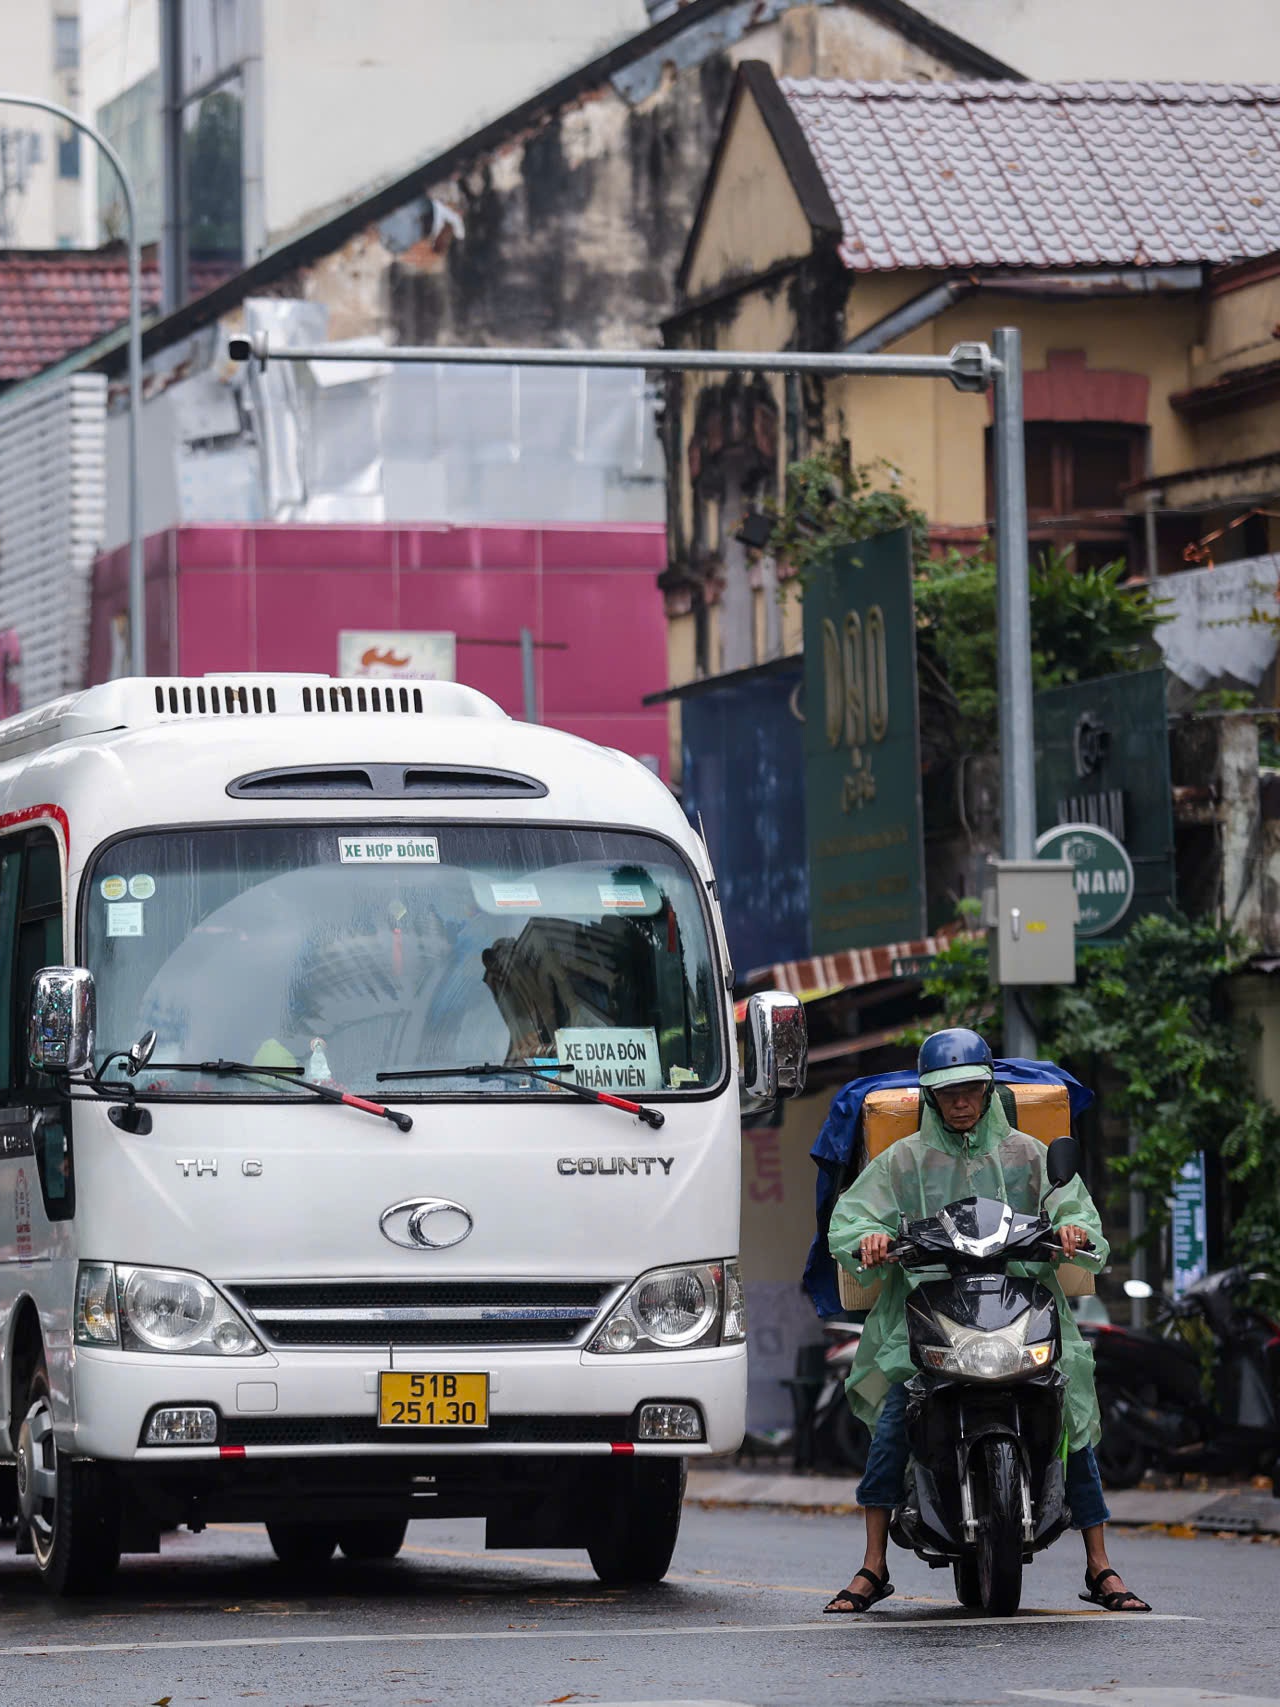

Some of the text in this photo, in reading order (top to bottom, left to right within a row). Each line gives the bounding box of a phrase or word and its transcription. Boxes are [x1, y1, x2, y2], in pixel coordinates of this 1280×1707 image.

[344, 840, 435, 860] XE HỢP ĐỒNG
[1076, 868, 1126, 894] NAM
[565, 1039, 647, 1060] XE ĐƯA ĐÓN
[575, 1065, 646, 1087] NHÂN VIÊN
[176, 1159, 263, 1177] TH C
[556, 1157, 675, 1175] COUNTY
[410, 1375, 457, 1397] 51B
[391, 1401, 476, 1425] 251.30
